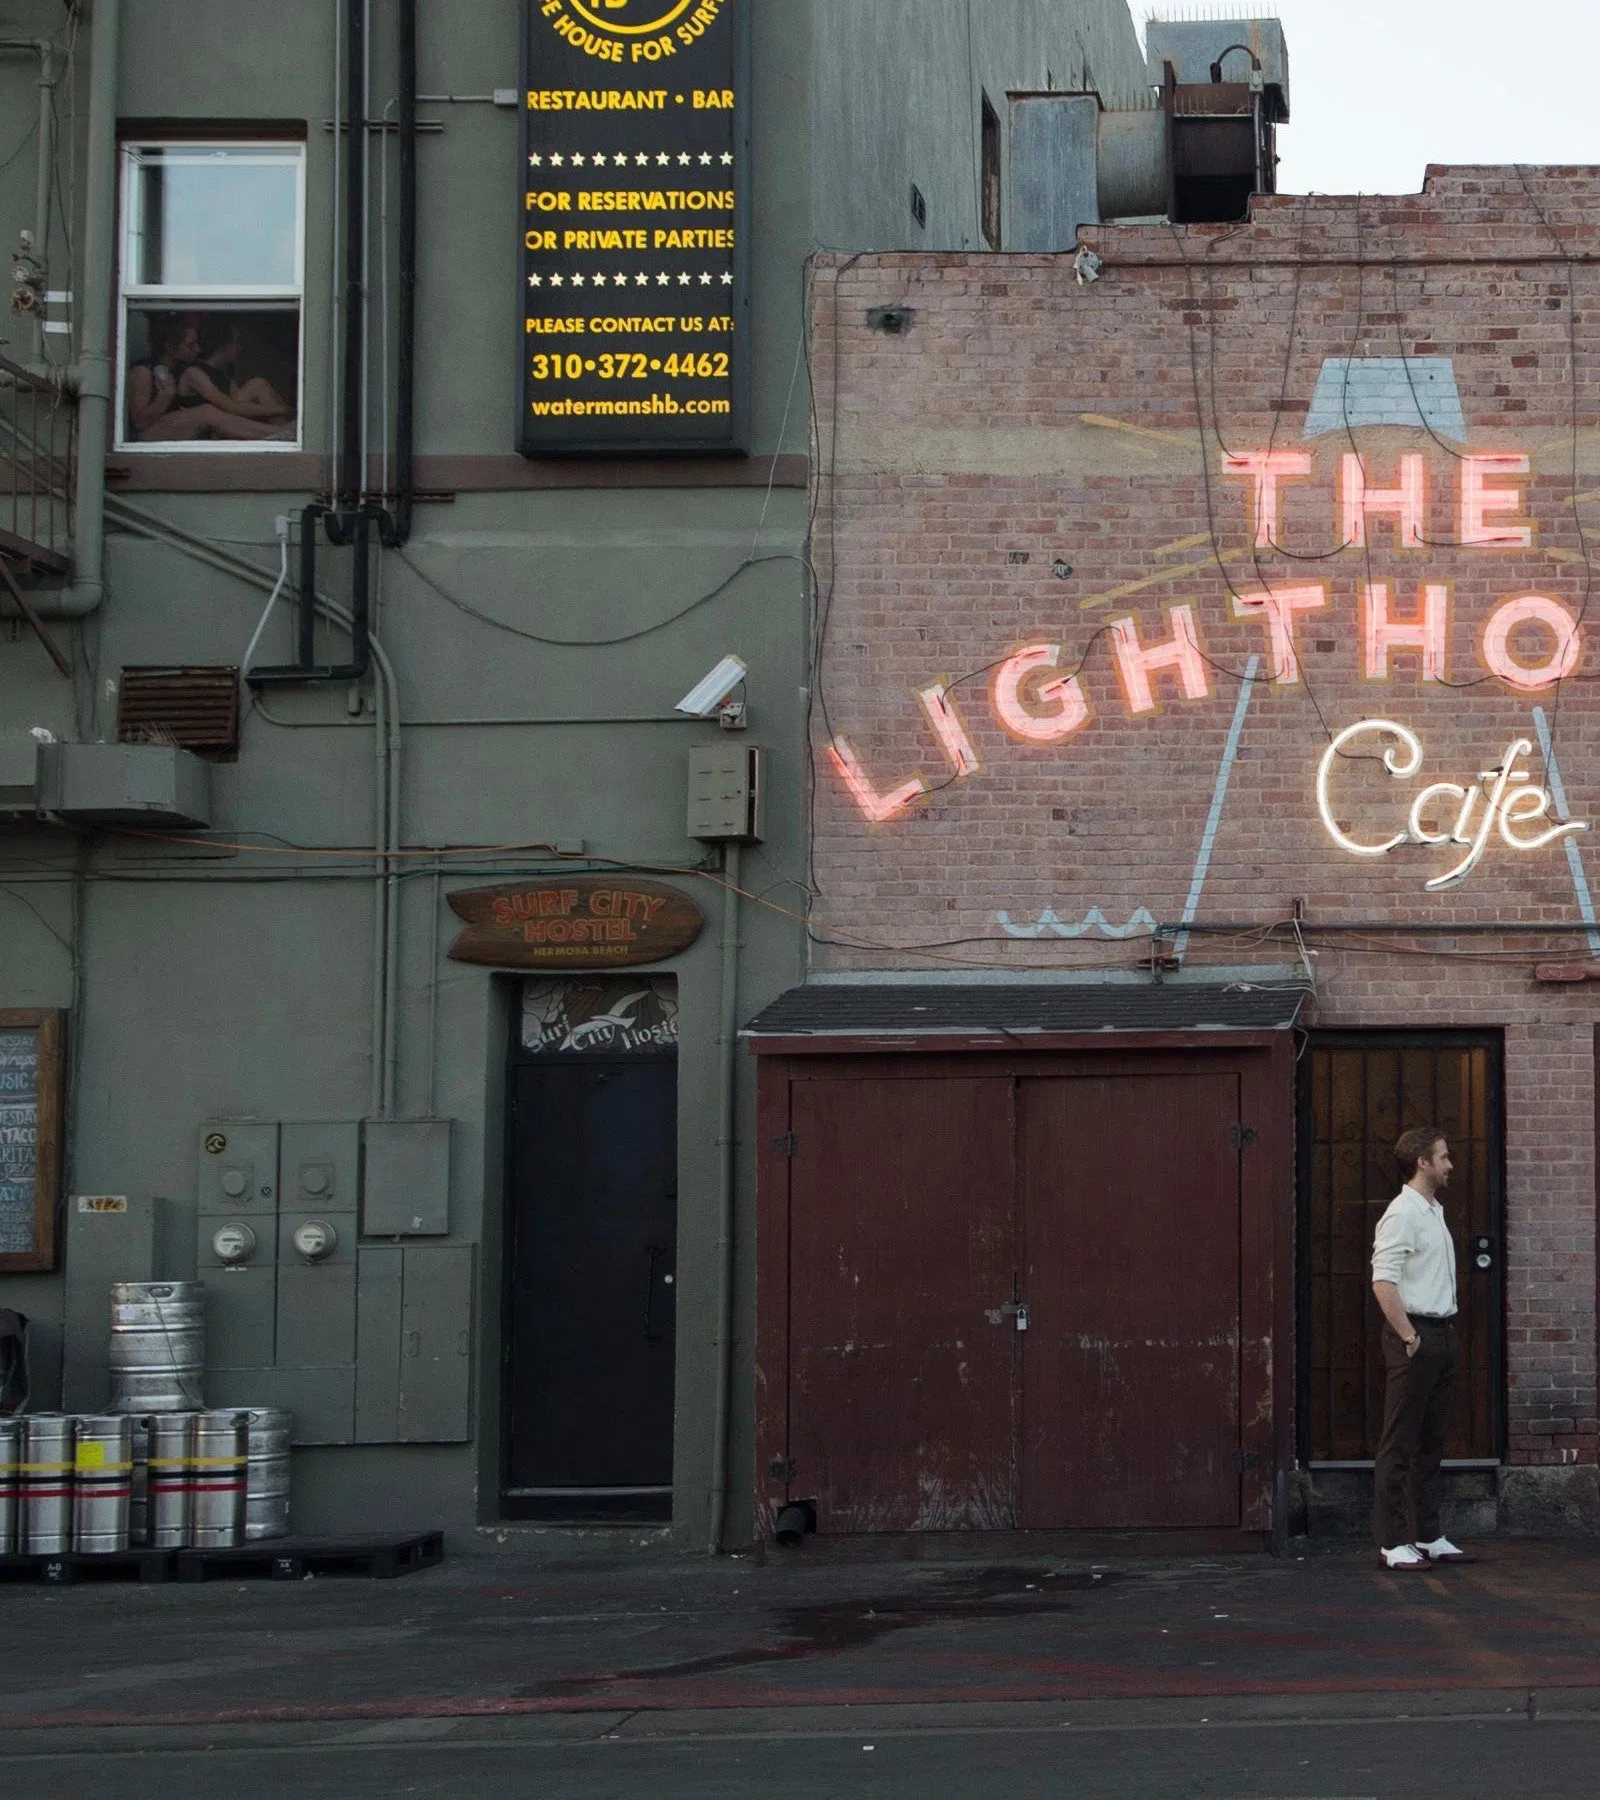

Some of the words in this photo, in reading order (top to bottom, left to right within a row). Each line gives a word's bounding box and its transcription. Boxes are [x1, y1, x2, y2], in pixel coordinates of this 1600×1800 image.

[541, 0, 562, 17] E
[553, 14, 625, 62] HOUSE
[631, 35, 677, 63] FOR
[677, 0, 724, 45] SURF
[527, 89, 668, 111] RESTAURANT
[692, 89, 735, 109] BAR
[526, 191, 572, 211] FOR
[578, 190, 735, 211] RESERVATIONS
[525, 230, 558, 250] OR
[564, 229, 648, 250] PRIVATE
[654, 228, 734, 249] PARTIES
[526, 317, 585, 334] PLEASE
[589, 316, 675, 334] CONTACT
[680, 316, 704, 333] US
[531, 393, 730, 416] watermanshb.com
[1220, 451, 1532, 549] THE
[492, 889, 580, 923] SURF
[589, 889, 667, 922] CITY
[524, 917, 637, 943] HOSTEL
[533, 945, 589, 957] HERMOSA
[592, 944, 629, 956] BEACH
[571, 1024, 616, 1051] City
